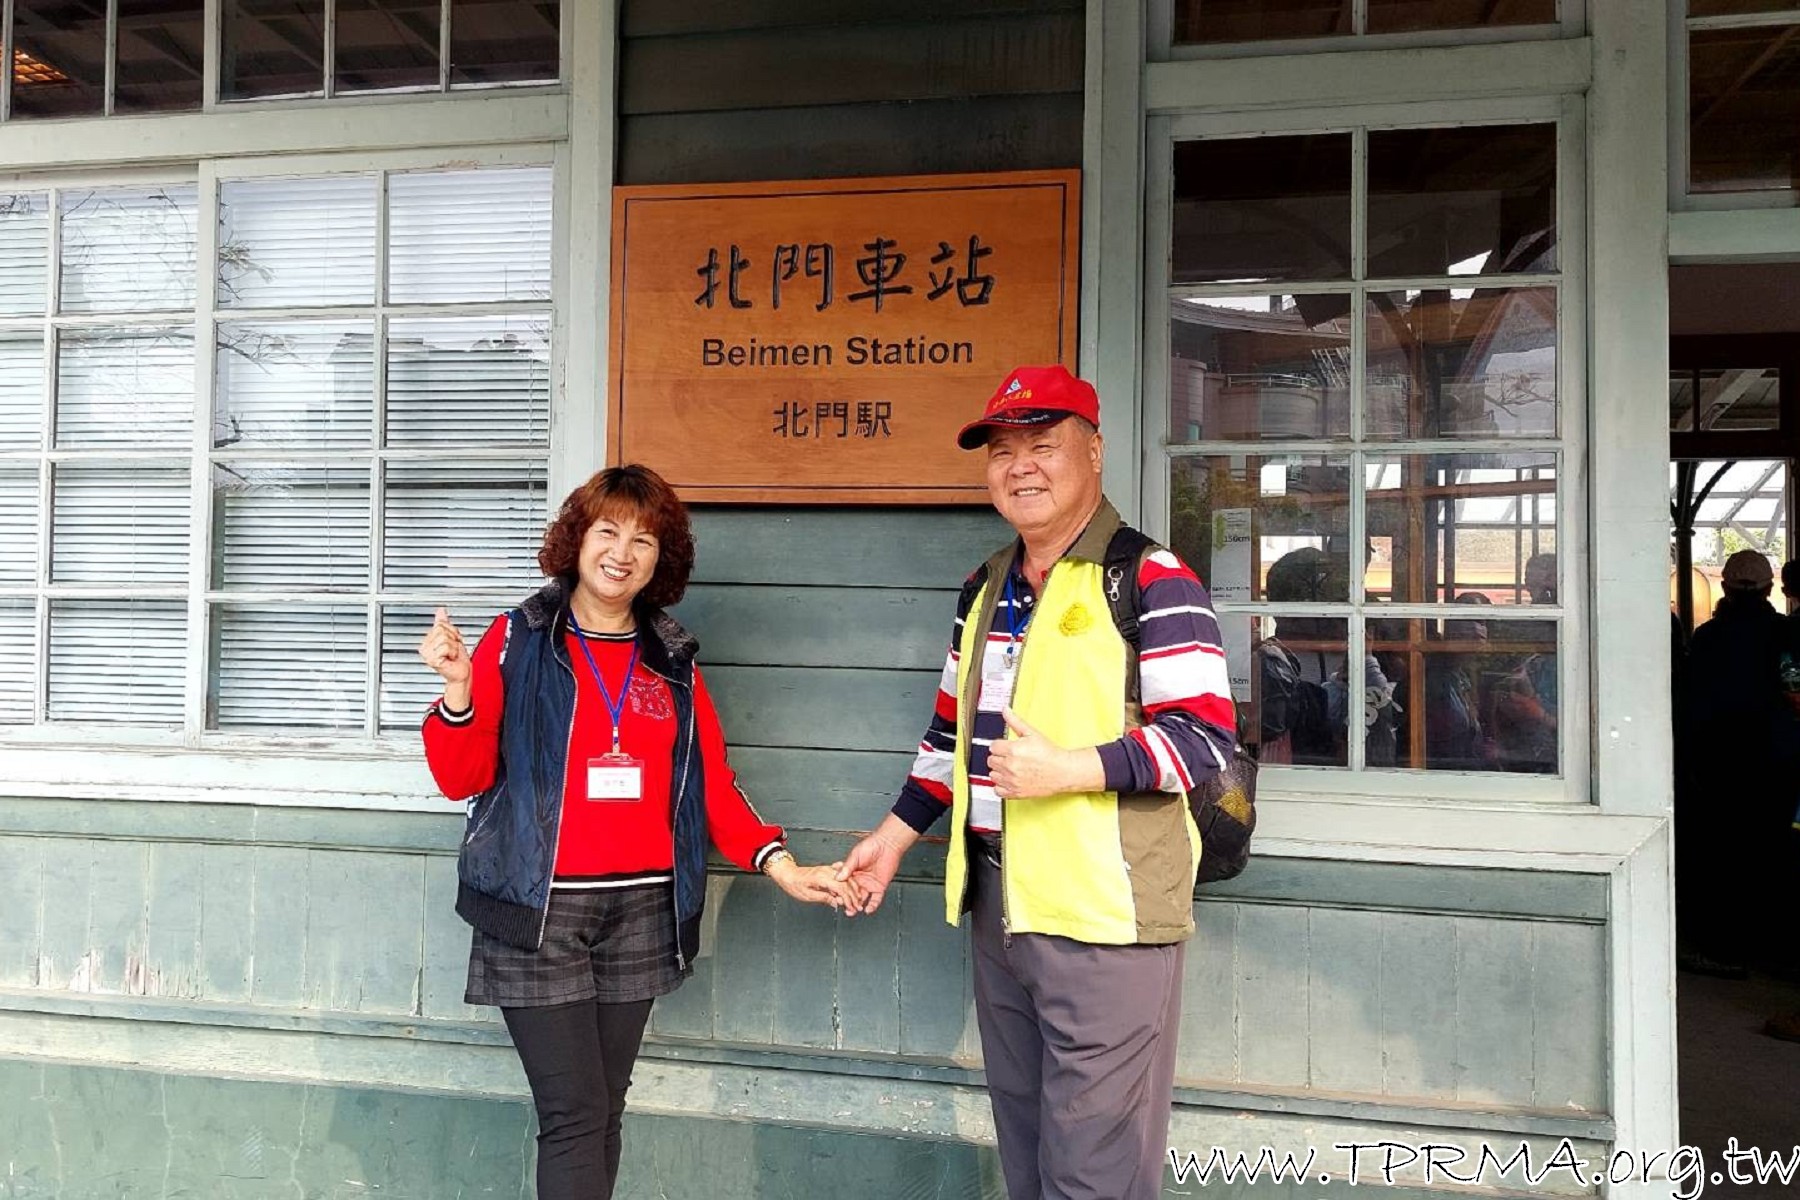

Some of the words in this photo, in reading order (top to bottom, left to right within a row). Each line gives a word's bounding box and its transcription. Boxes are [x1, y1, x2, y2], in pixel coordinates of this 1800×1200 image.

[695, 235, 998, 313] 北門車站
[702, 338, 833, 366] Beimen
[847, 336, 973, 365] Station
[773, 402, 892, 439] 北門駅
